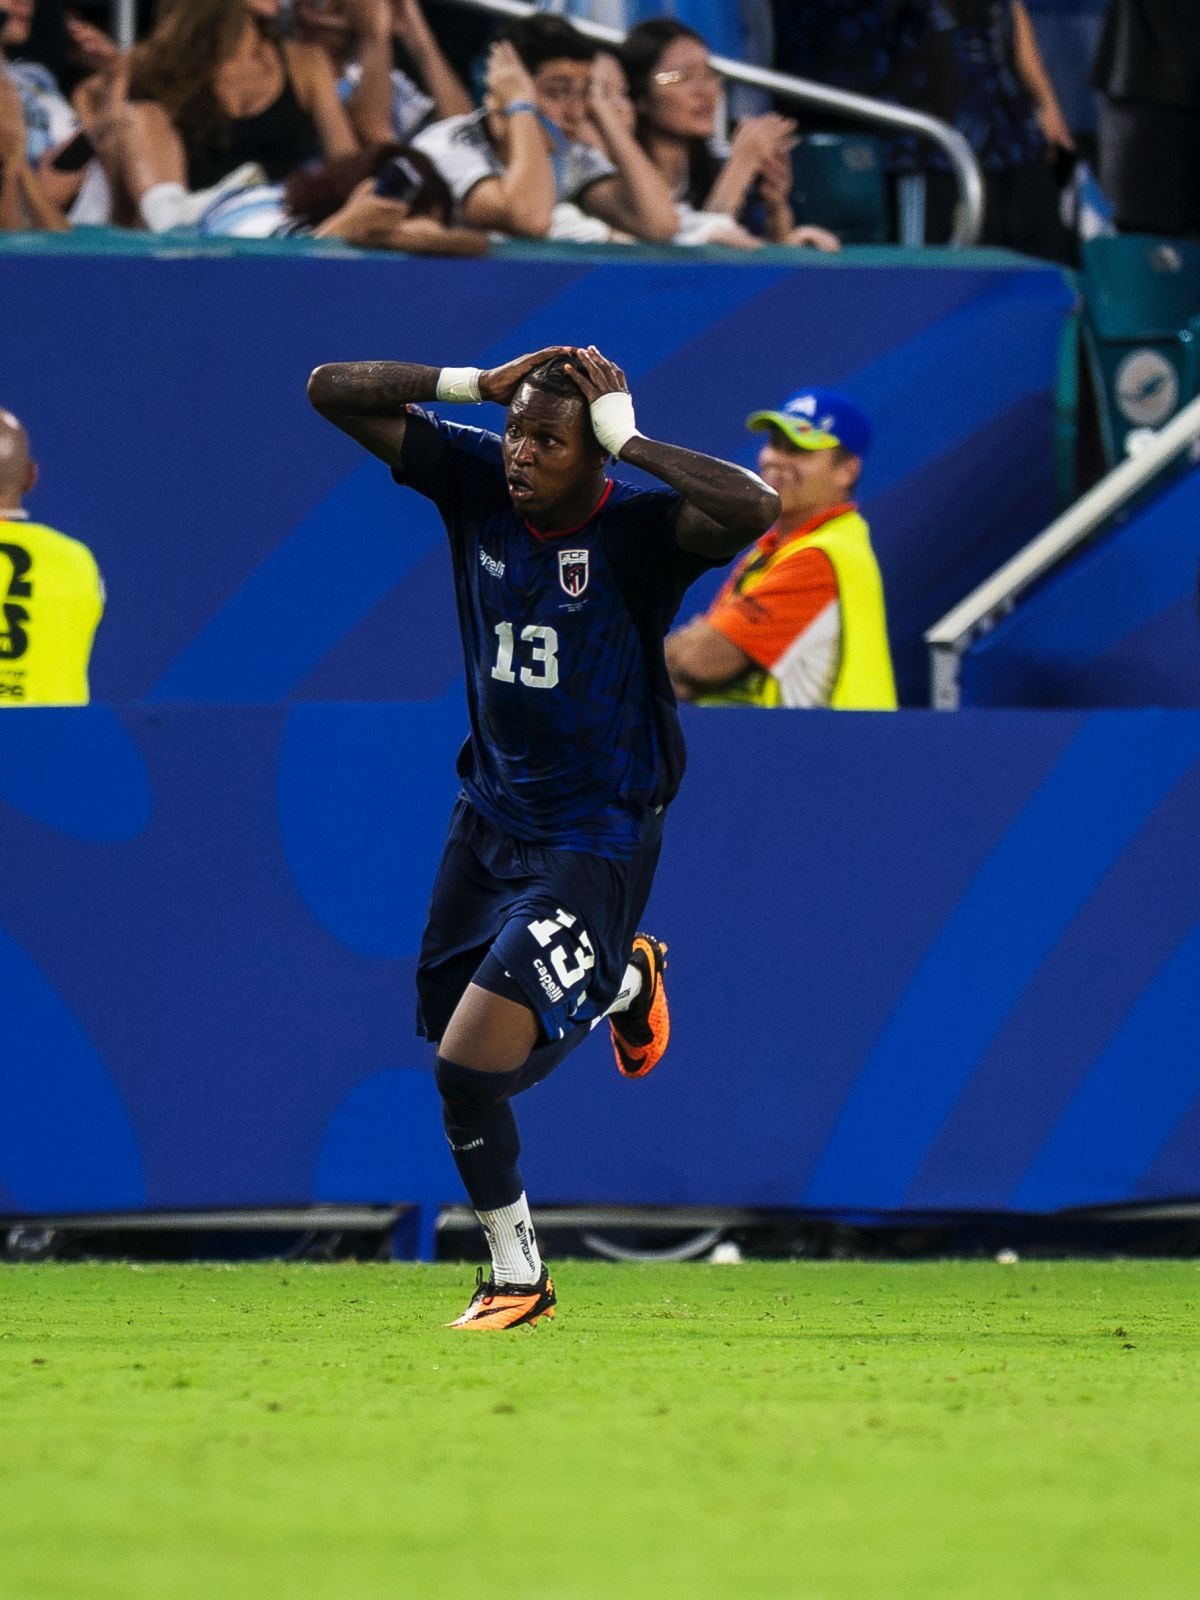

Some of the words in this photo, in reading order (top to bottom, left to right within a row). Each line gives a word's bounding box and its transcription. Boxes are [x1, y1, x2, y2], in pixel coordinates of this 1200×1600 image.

[560, 551, 588, 560] FCF
[491, 620, 559, 688] 13
[527, 908, 595, 989] 13
